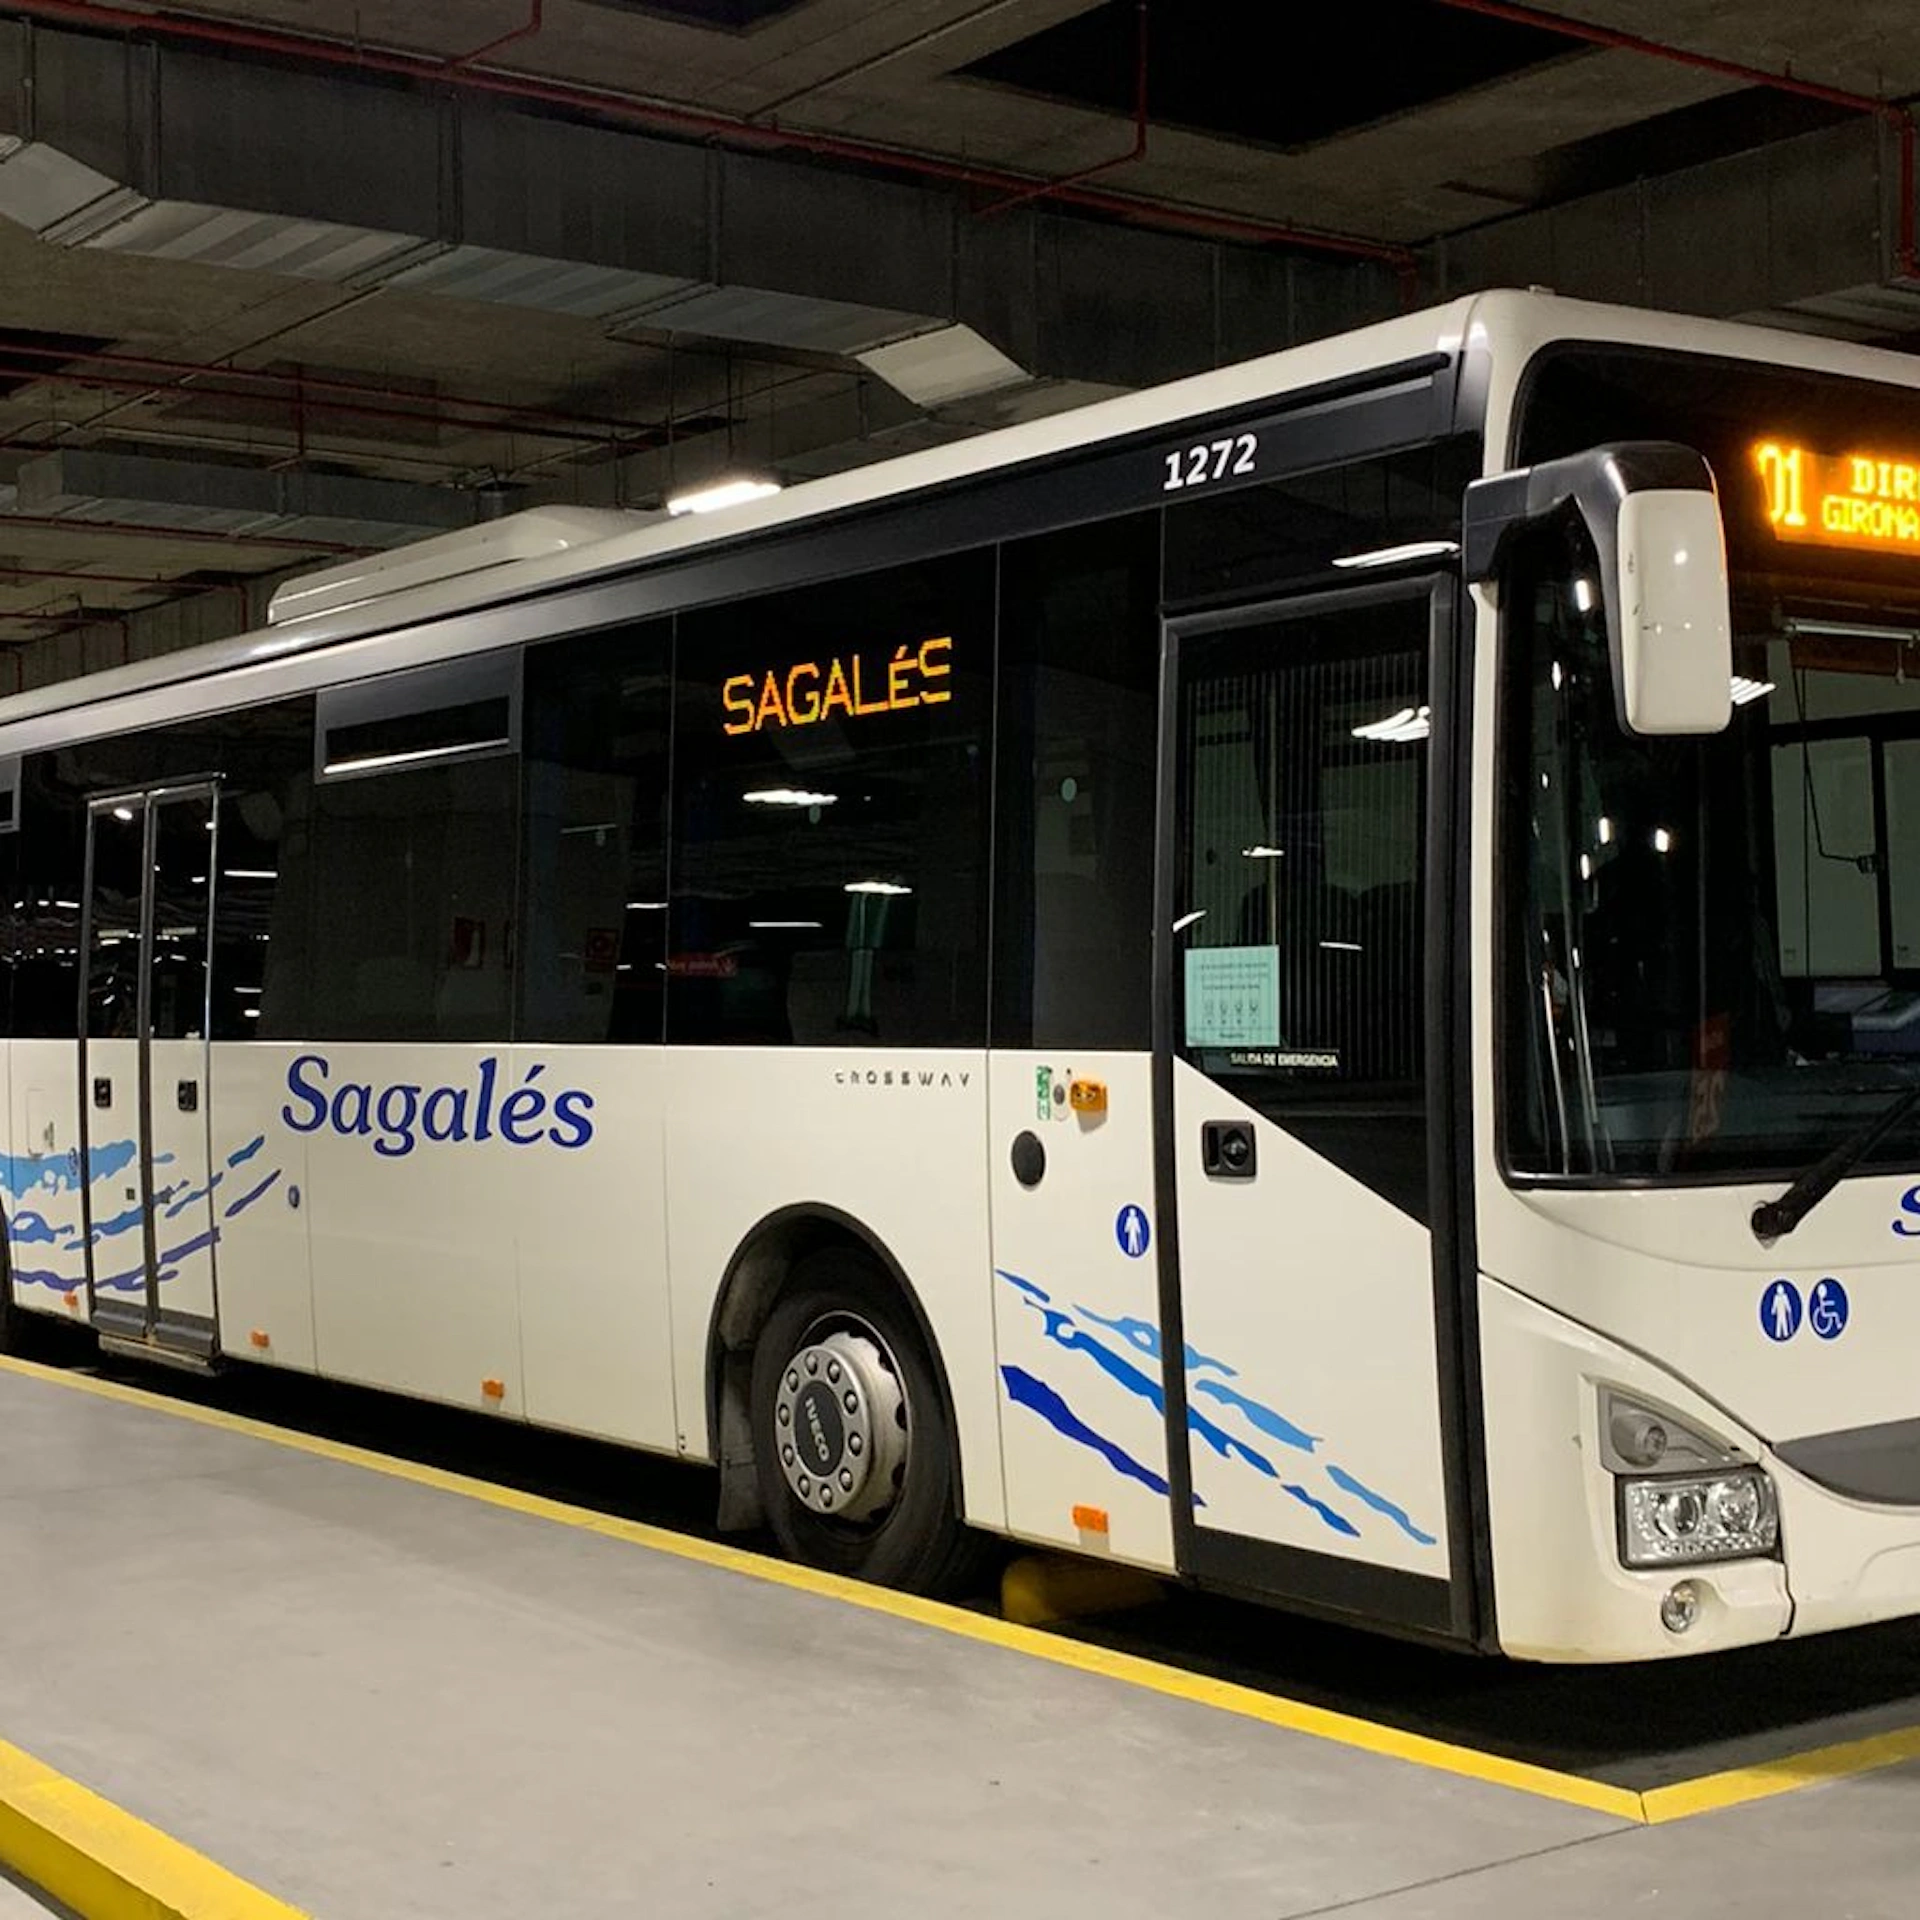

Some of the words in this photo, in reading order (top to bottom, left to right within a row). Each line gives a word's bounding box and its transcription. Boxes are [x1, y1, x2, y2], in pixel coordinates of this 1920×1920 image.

[1163, 433, 1258, 491] 1272
[1822, 494, 1920, 541] GIRONA
[722, 635, 953, 737] SAGALÉS
[834, 1070, 970, 1087] CROSSWAY
[1263, 1053, 1277, 1066] DE
[281, 1053, 596, 1157] Sagalés
[805, 1397, 830, 1462] IVECO
